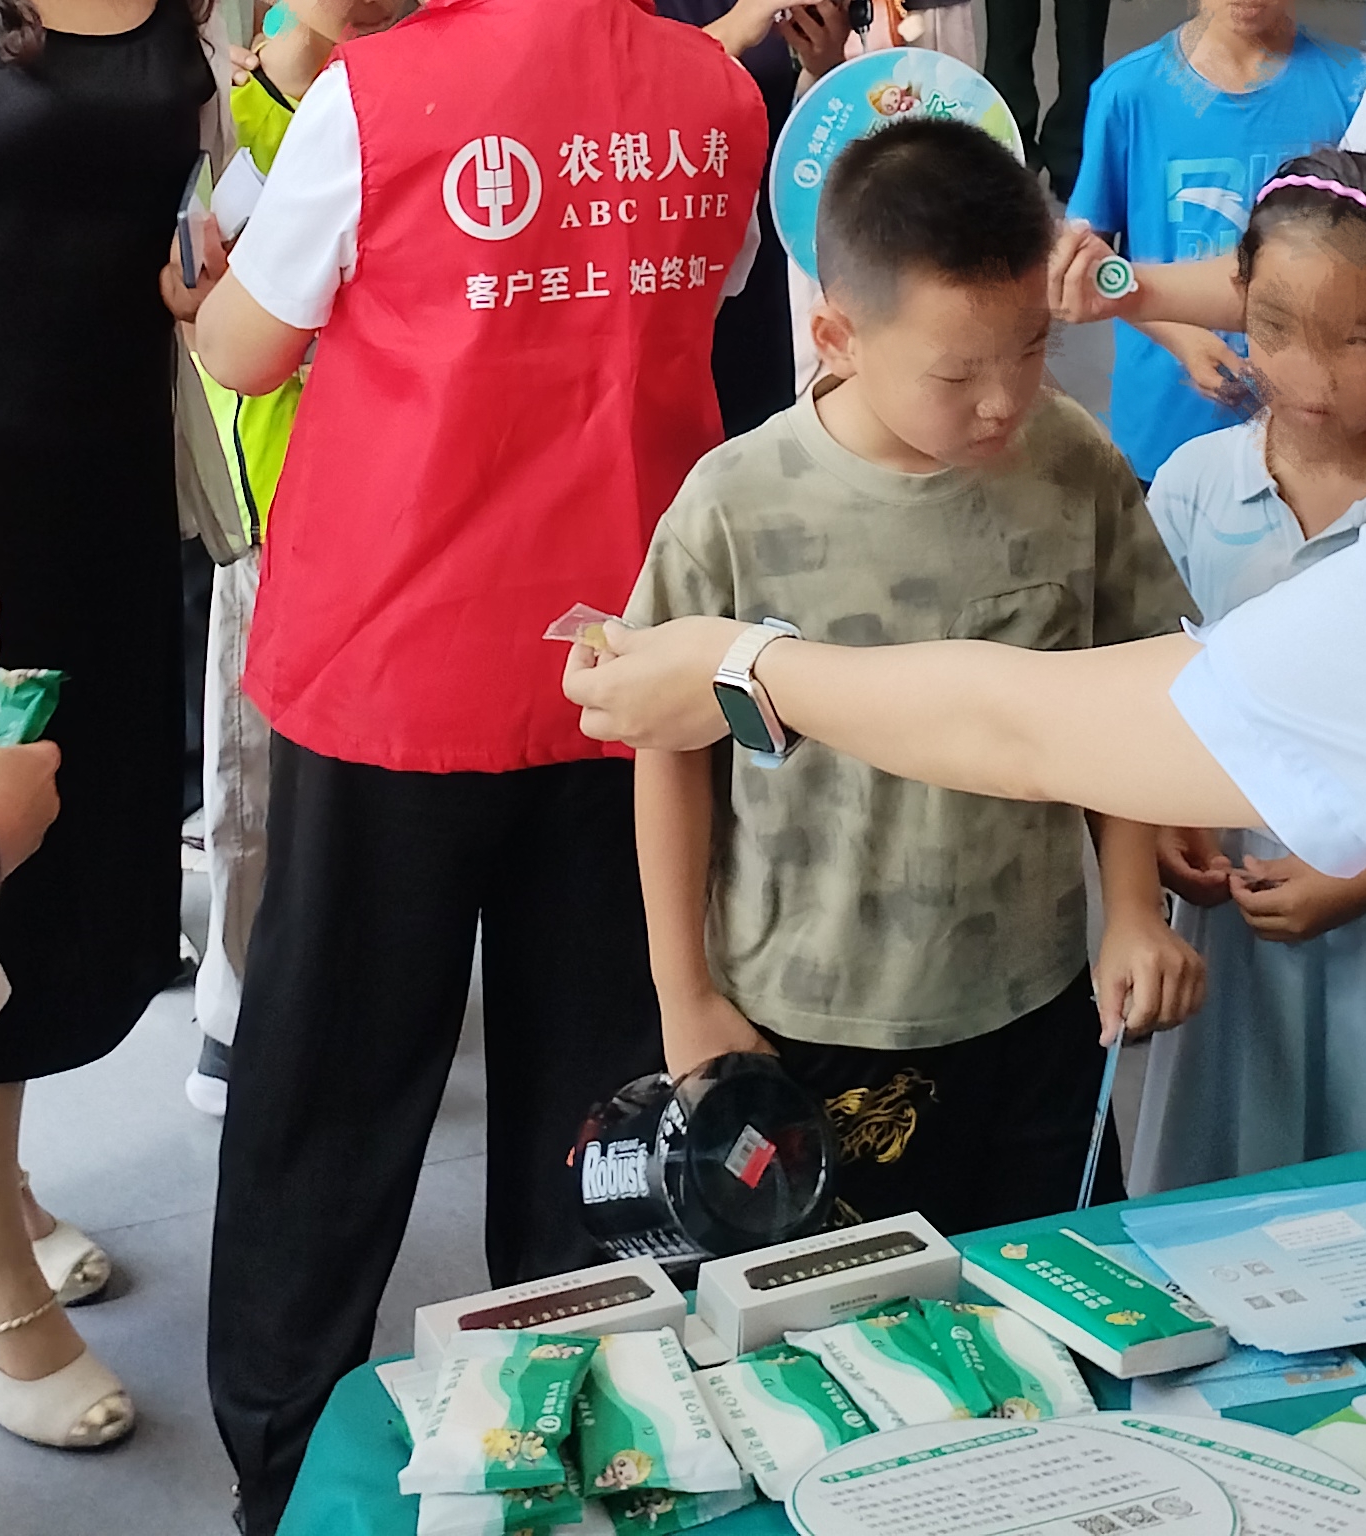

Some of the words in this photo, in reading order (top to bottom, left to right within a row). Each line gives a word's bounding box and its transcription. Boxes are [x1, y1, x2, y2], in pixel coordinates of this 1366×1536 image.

[558, 128, 729, 186] 农银人寿
[560, 199, 638, 229] ABC
[659, 193, 729, 222] LIFE
[465, 262, 610, 310] 客户至上
[629, 254, 724, 296] 始终如一
[583, 1140, 650, 1204] Robust
